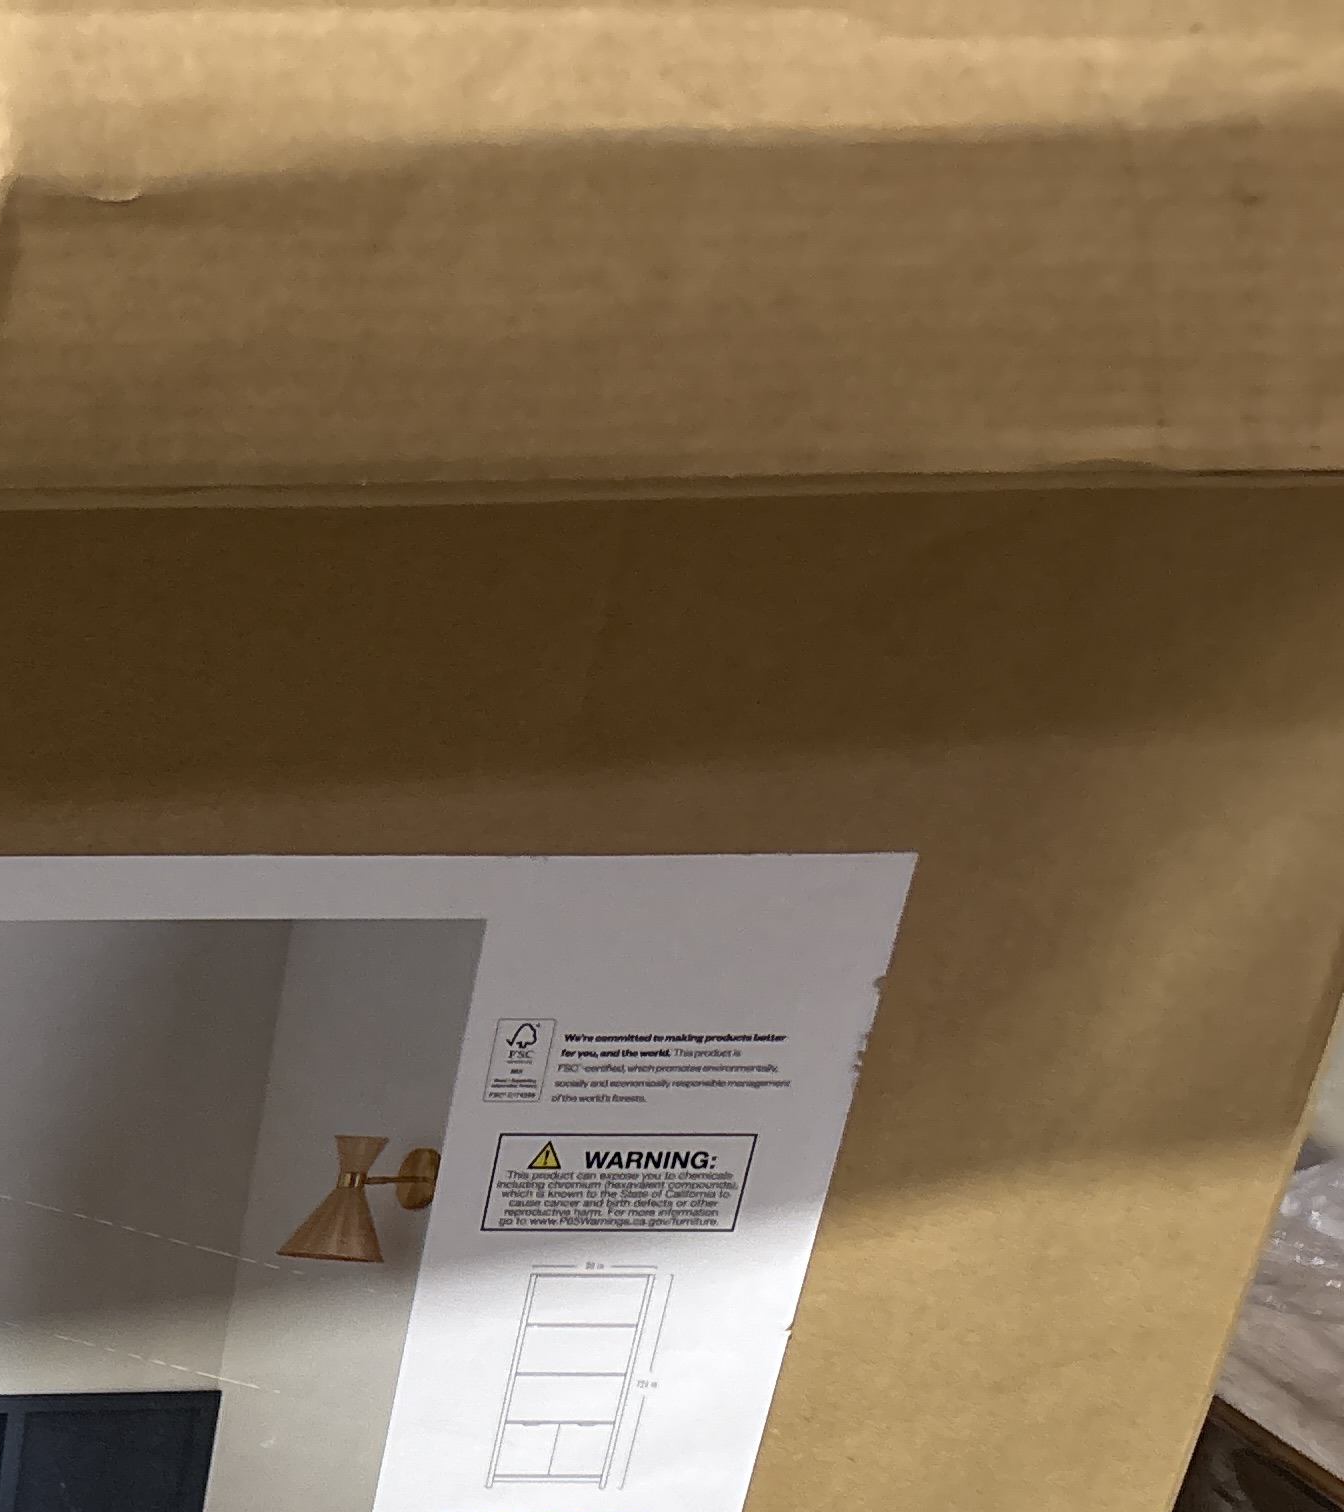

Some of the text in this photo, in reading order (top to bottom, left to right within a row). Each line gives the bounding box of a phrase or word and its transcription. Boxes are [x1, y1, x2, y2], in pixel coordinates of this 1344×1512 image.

[561, 1049, 576, 1057] for
[600, 1049, 620, 1057] and
[622, 1049, 638, 1057] the
[584, 1151, 718, 1169] WARNING:
